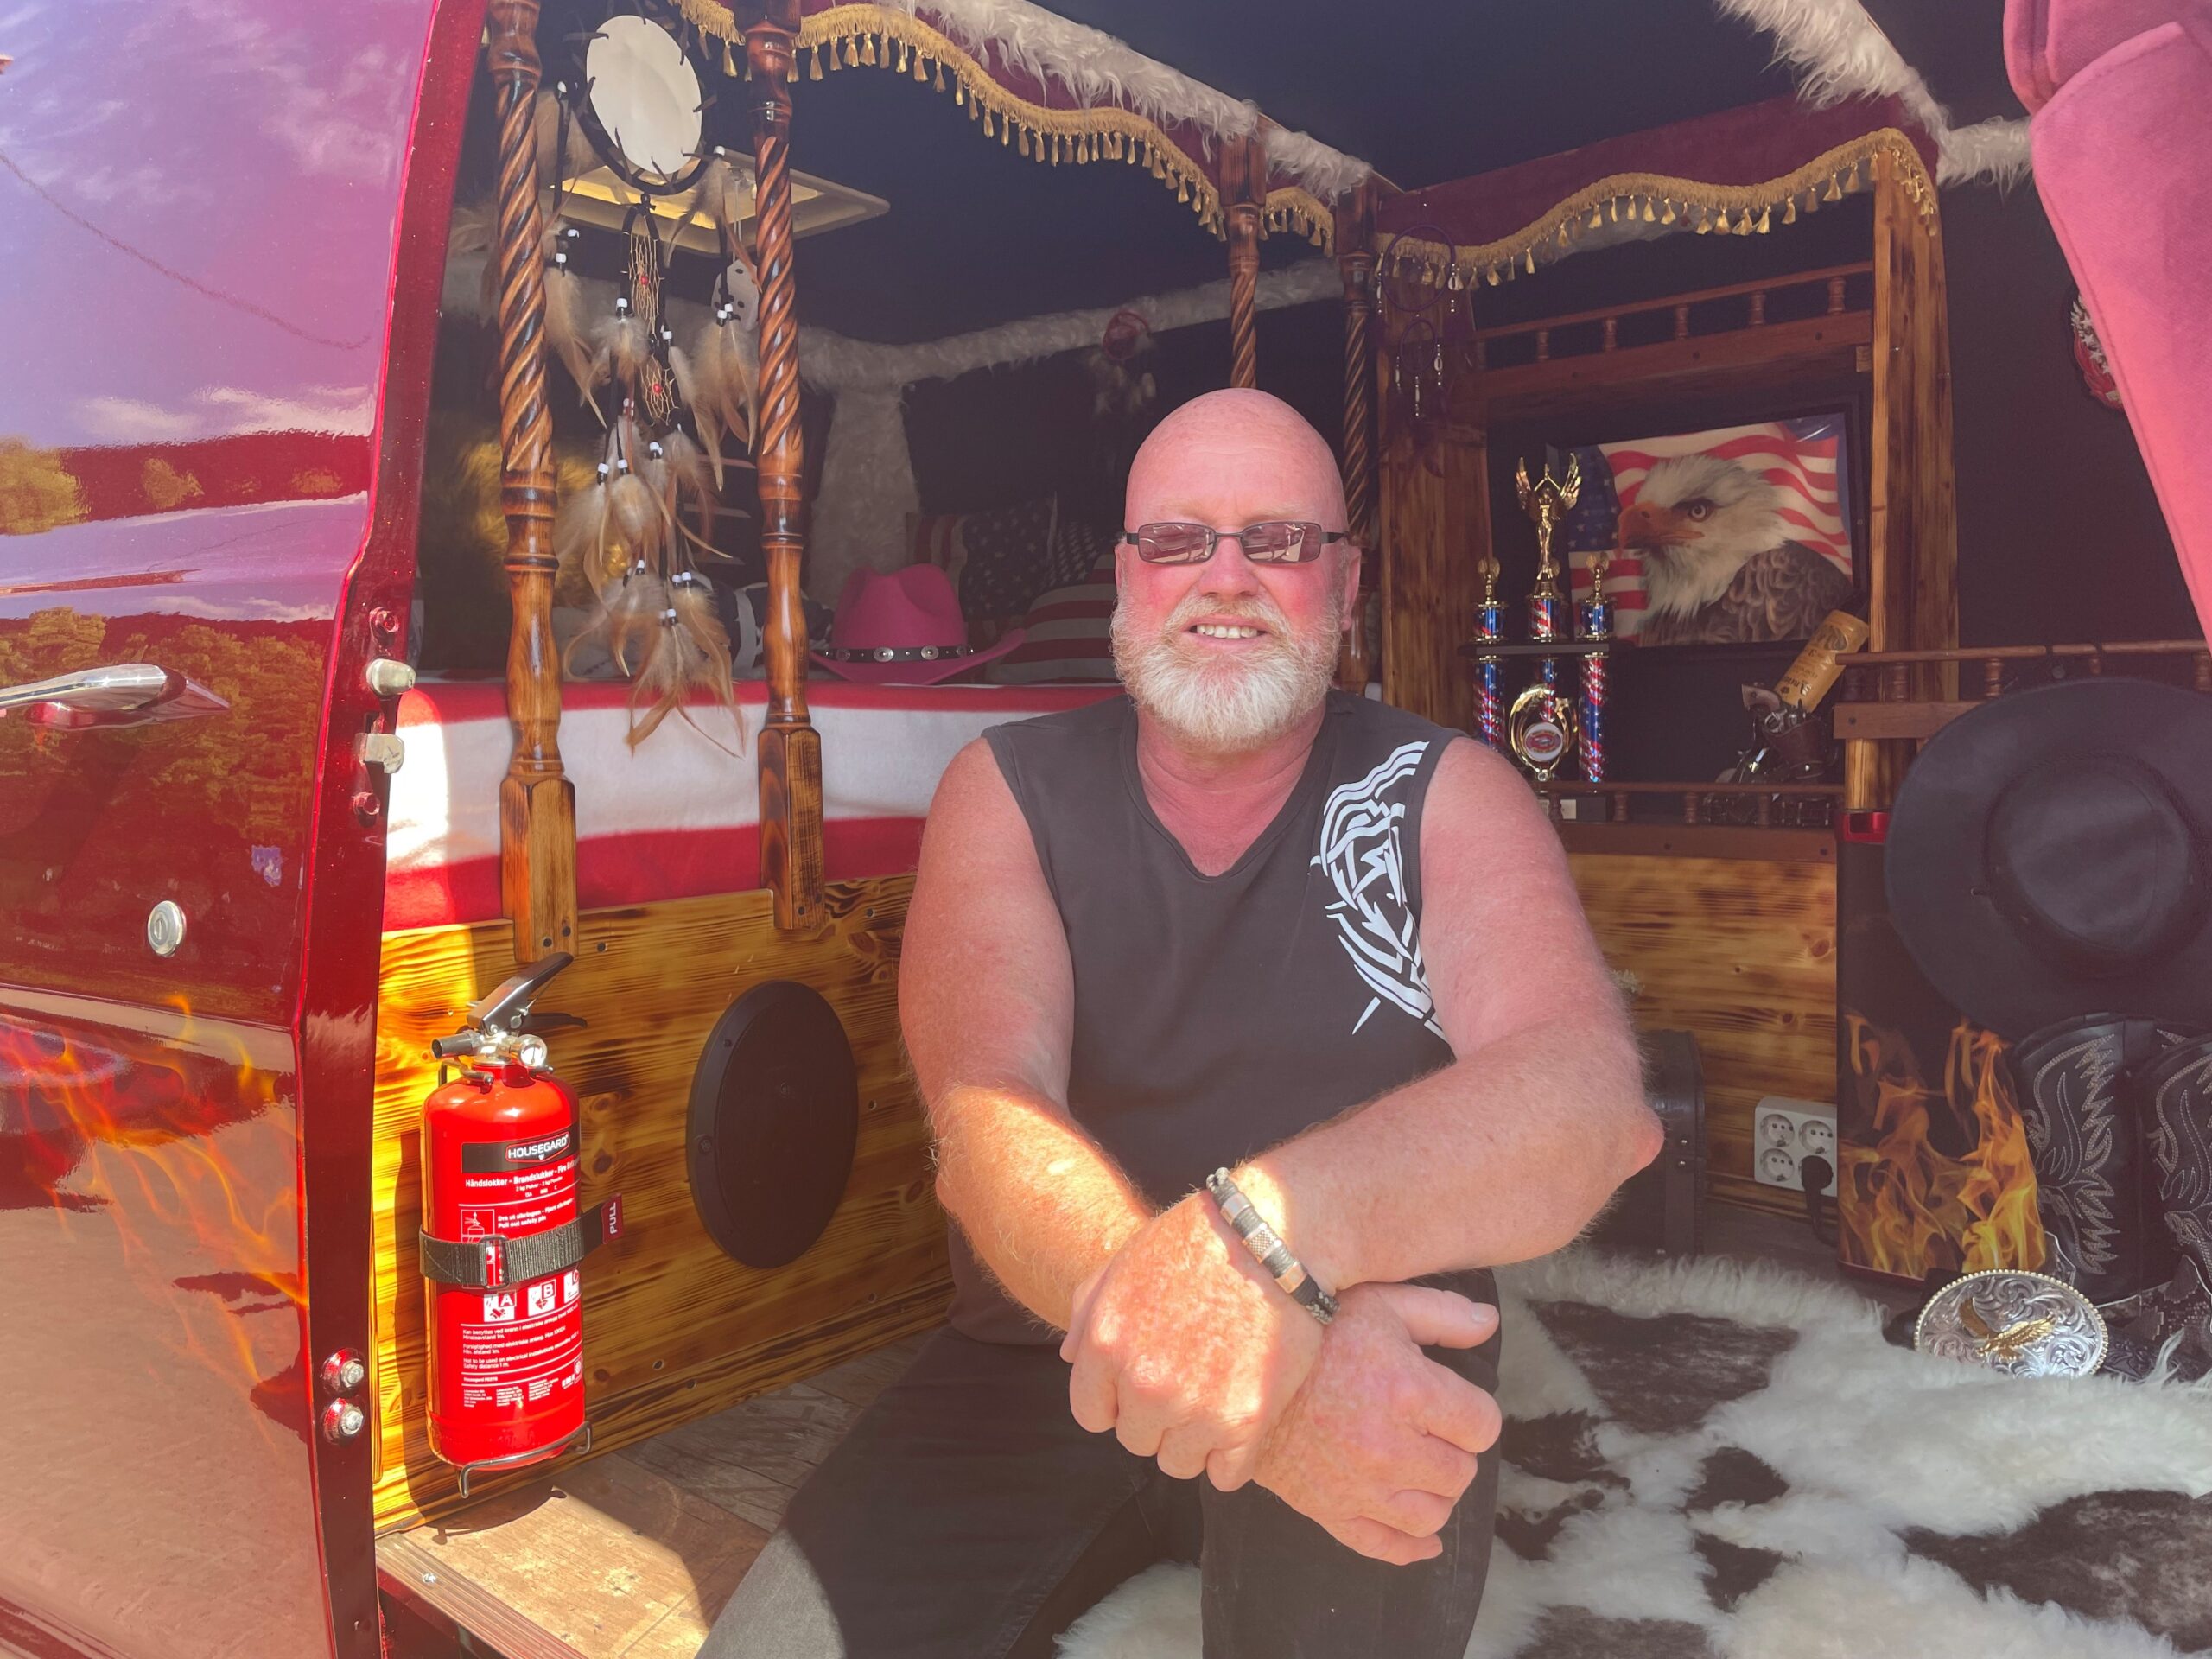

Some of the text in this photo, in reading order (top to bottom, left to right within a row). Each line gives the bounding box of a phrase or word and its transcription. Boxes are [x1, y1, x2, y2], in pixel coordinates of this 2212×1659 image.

[508, 1135, 567, 1159] HOUSEGARD
[609, 1201, 618, 1235] PULL
[500, 1293, 513, 1306] A
[543, 1283, 554, 1299] B
